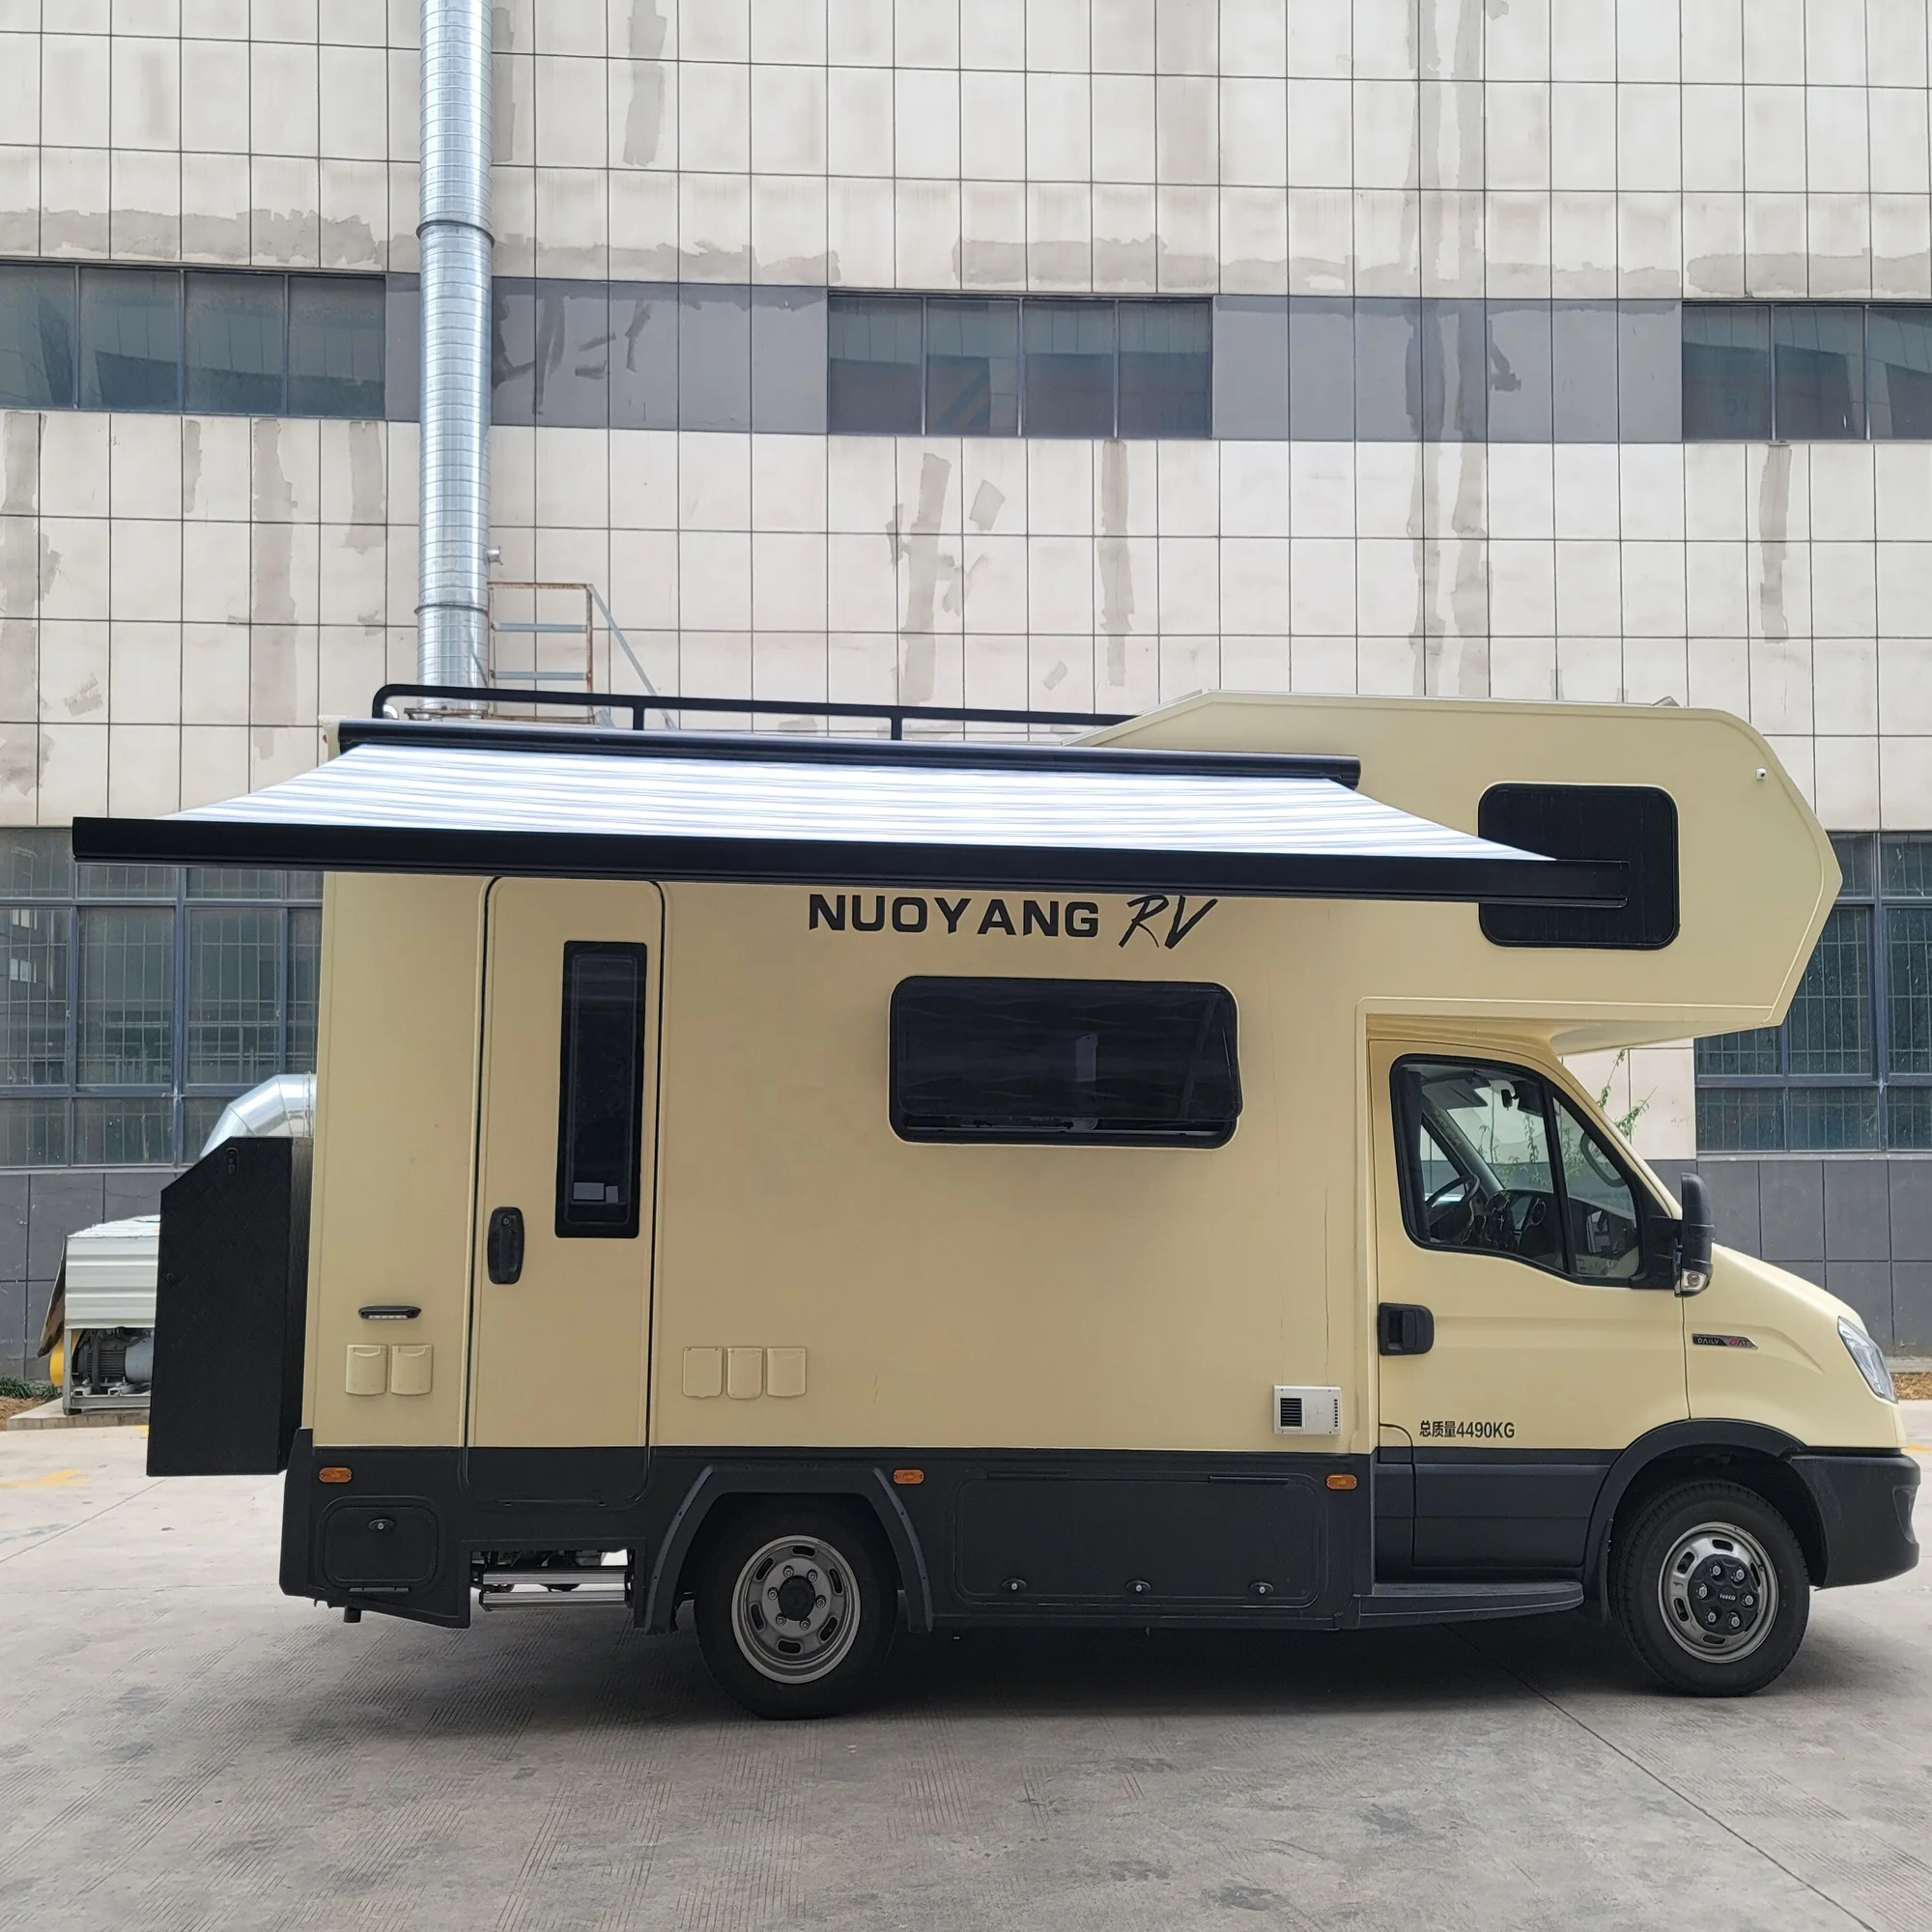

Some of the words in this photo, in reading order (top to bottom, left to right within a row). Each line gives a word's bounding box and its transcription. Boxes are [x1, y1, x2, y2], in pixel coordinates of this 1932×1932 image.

[809, 894, 1099, 938] NUOYANG
[1118, 895, 1219, 950] RV
[1419, 1420, 1515, 1438] 总质量4490KG
